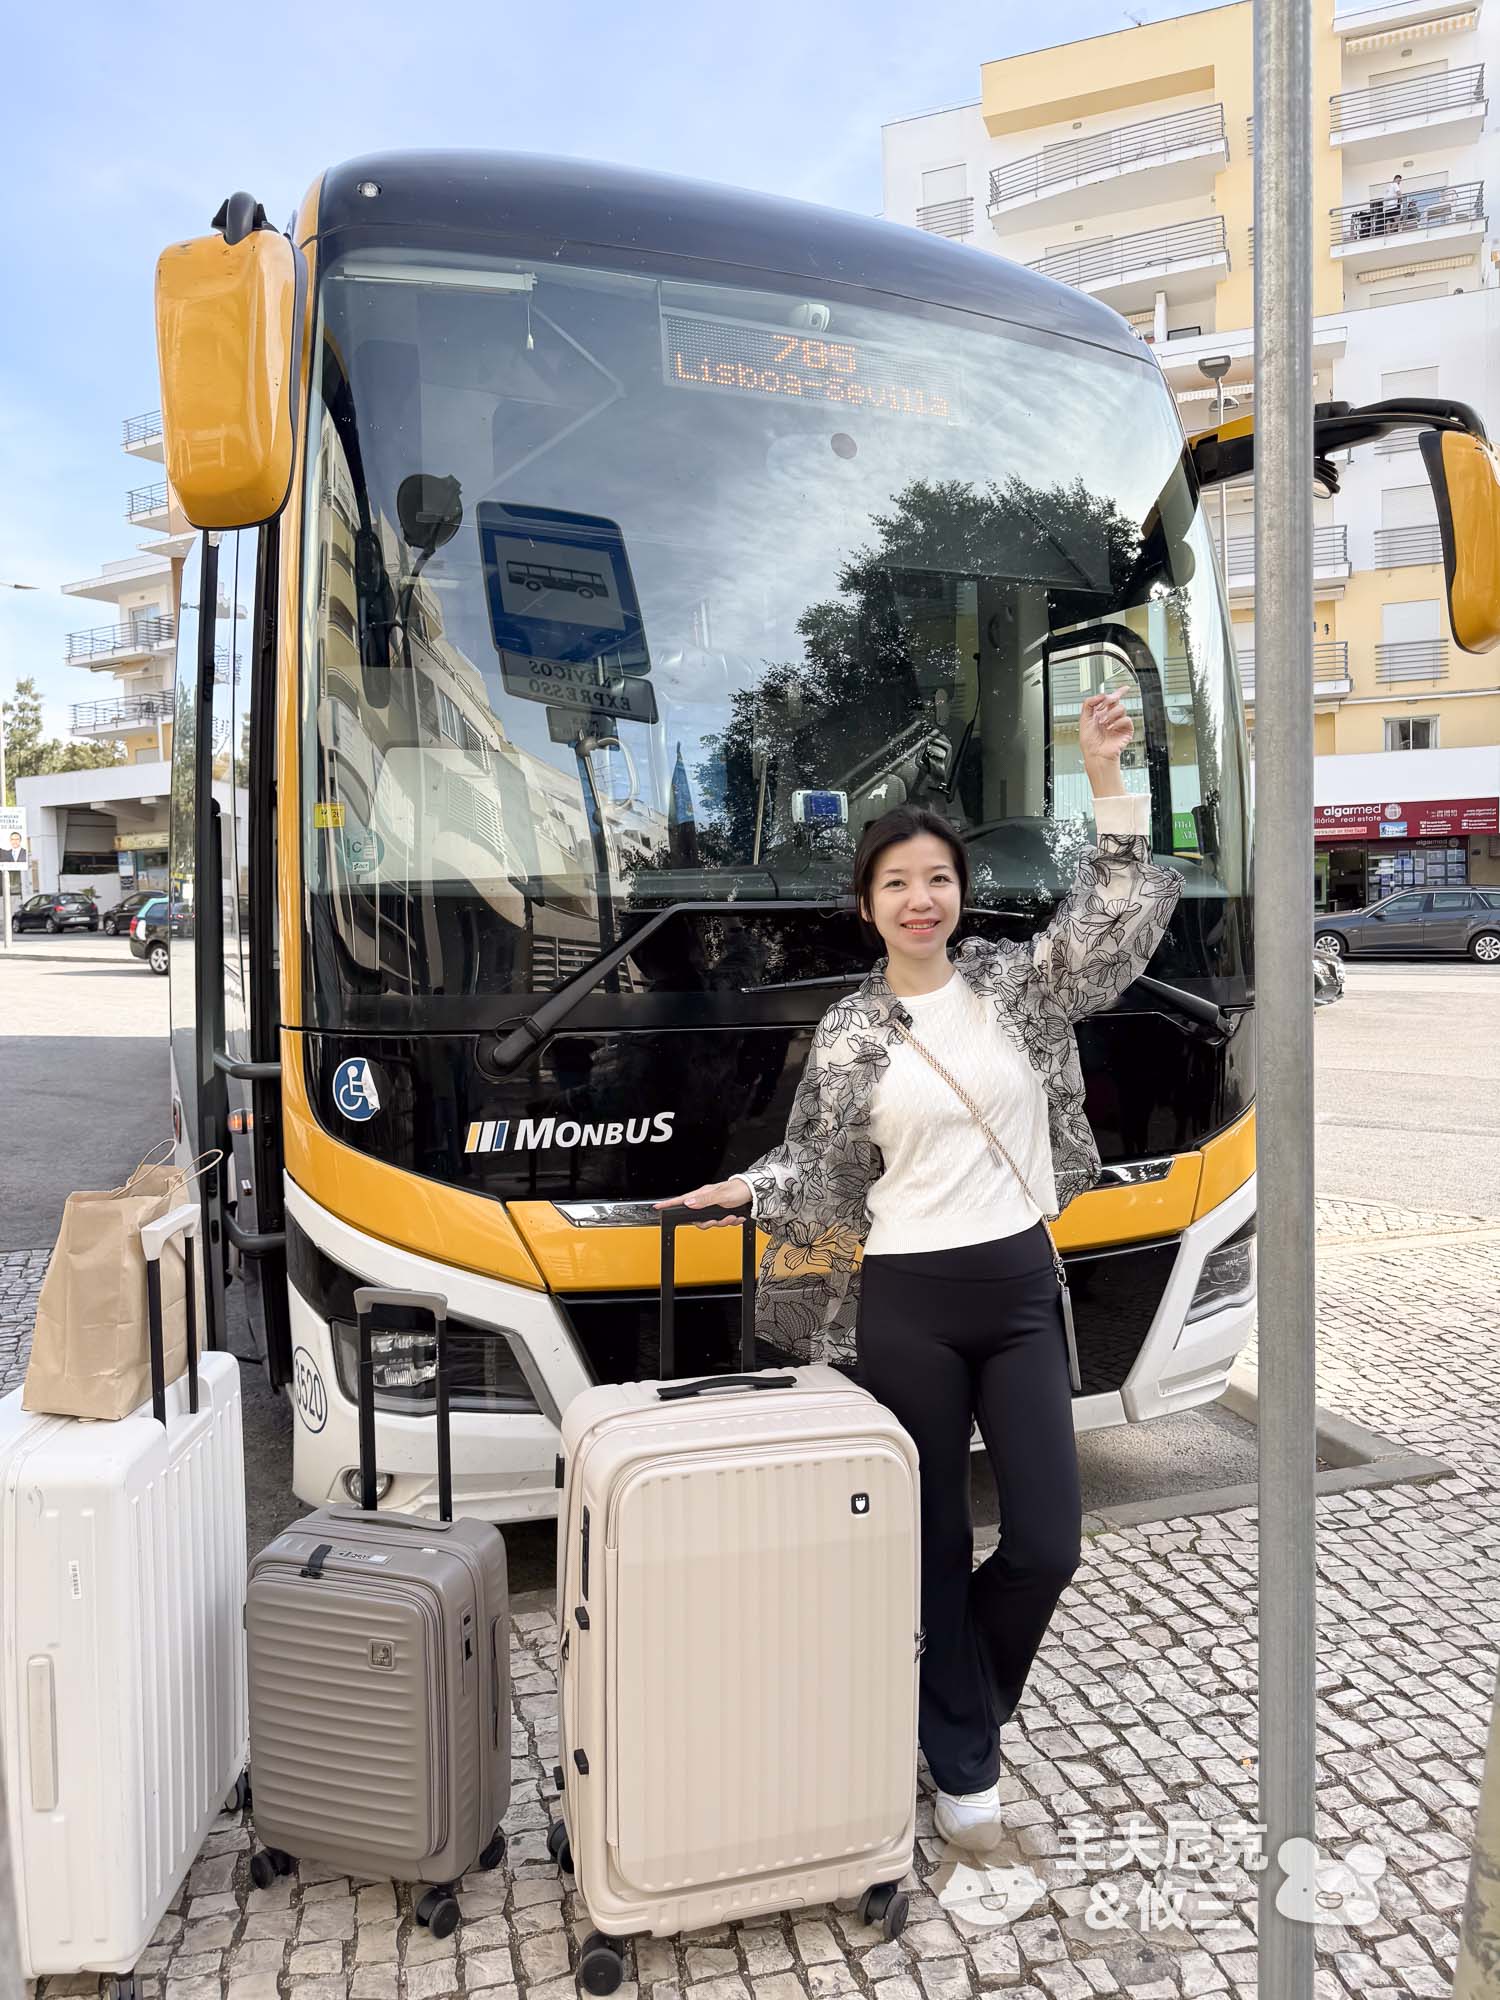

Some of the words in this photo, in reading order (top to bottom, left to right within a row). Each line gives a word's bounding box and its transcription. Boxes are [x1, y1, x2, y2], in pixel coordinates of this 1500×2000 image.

[772, 334, 857, 373] 785
[1323, 803, 1382, 818] algarmed
[1357, 815, 1382, 823] estate
